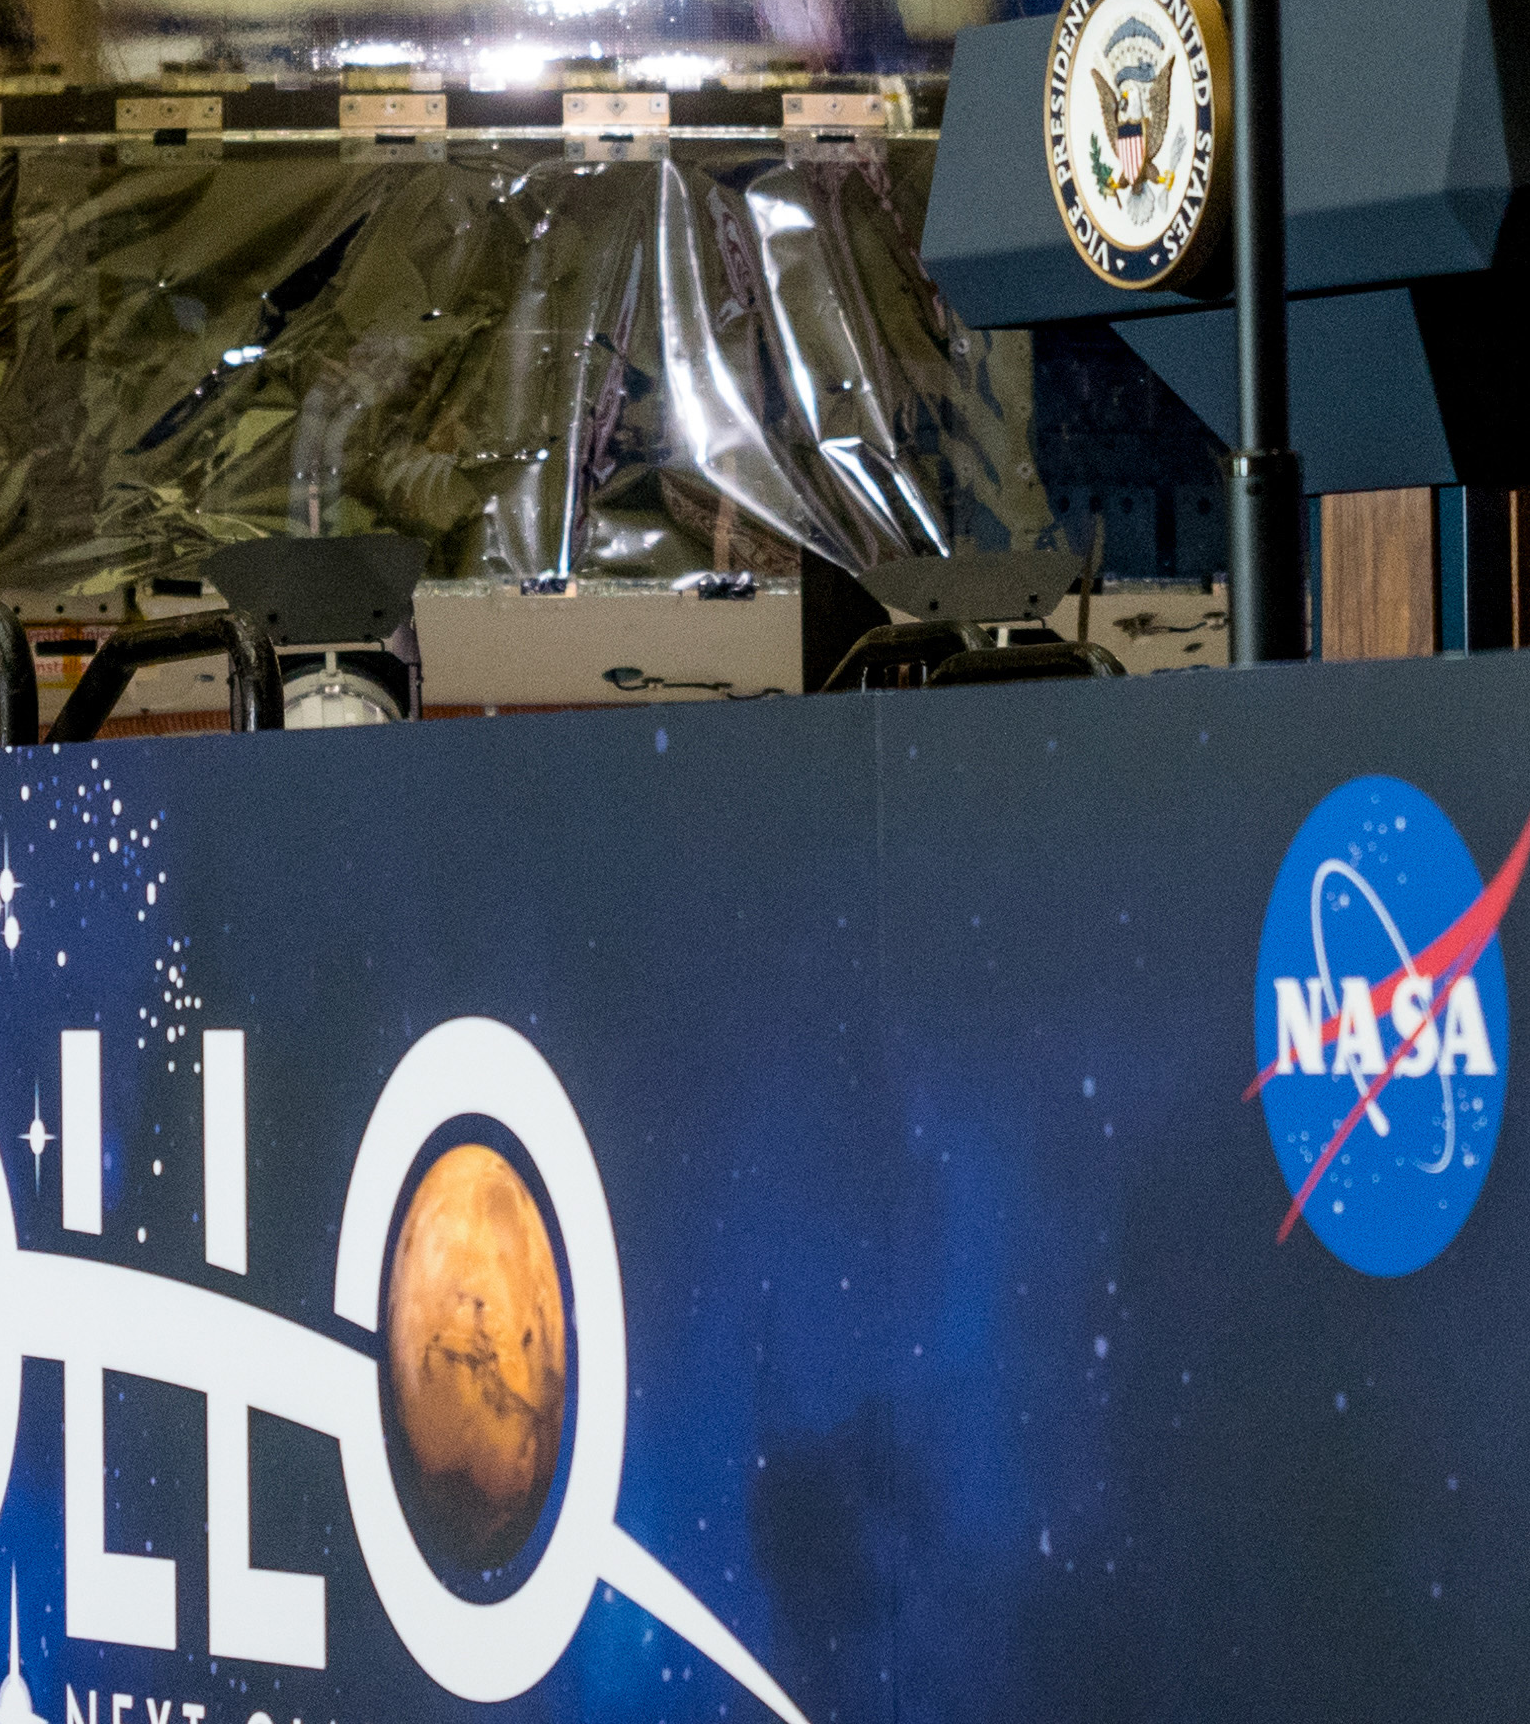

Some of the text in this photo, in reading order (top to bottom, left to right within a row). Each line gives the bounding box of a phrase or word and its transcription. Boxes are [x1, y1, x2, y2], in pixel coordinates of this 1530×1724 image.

[1065, 193, 1112, 273] VICE
[1162, 130, 1213, 264] STATES
[1273, 974, 1498, 1078] NASA
